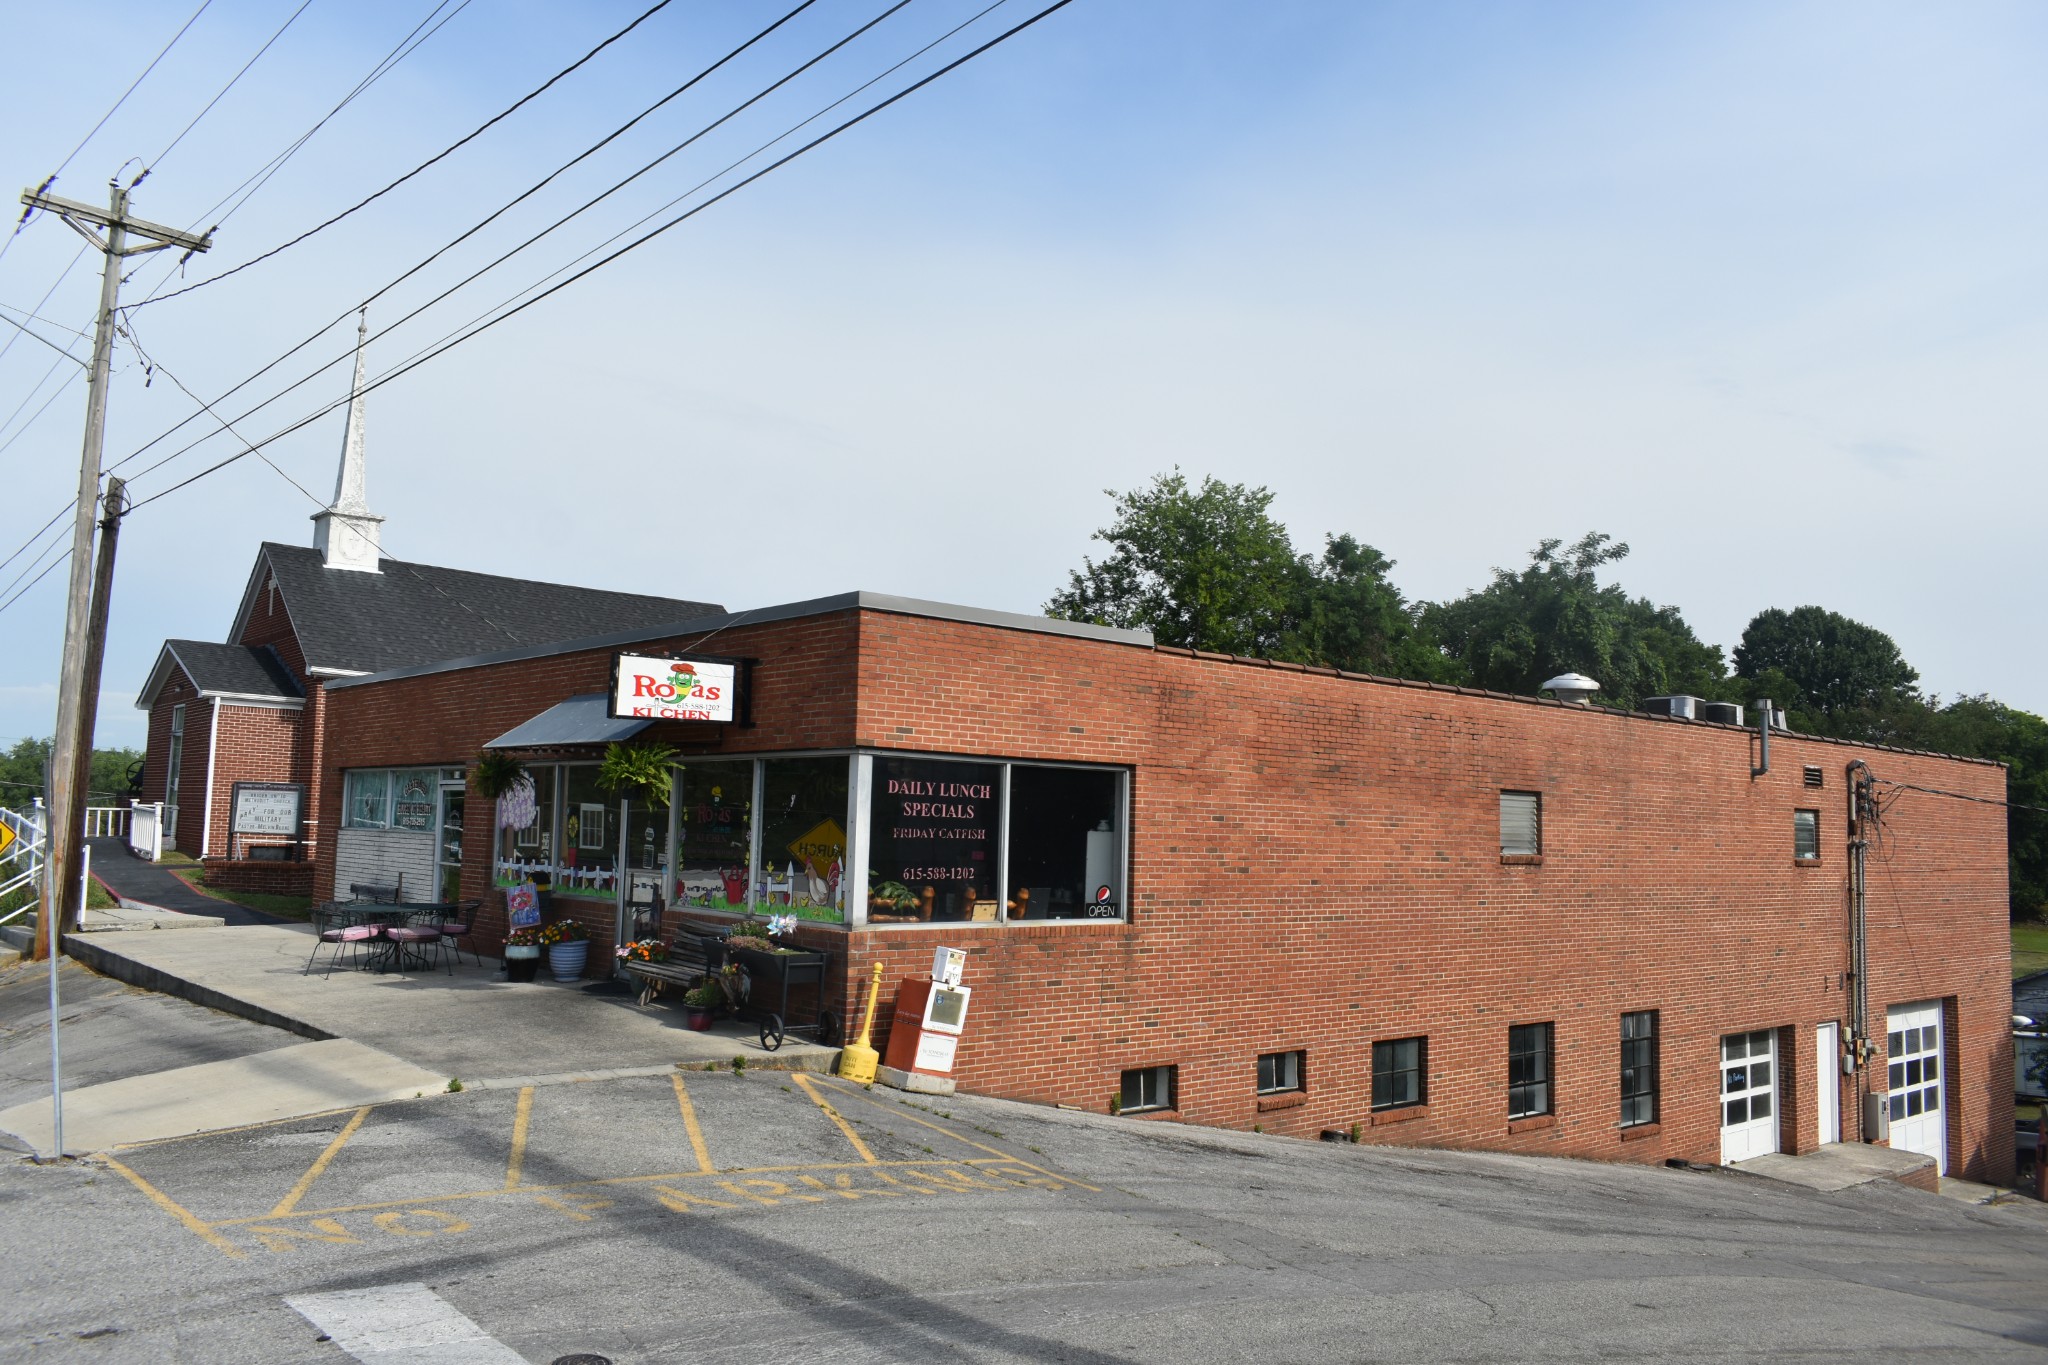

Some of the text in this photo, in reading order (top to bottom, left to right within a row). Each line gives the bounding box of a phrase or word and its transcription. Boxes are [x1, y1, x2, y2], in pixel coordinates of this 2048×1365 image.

[676, 703, 720, 711] 615-588-1202
[888, 780, 991, 799] DAILY LUNCH
[903, 802, 975, 818] SPECIALS
[254, 815, 282, 823] MILITARY
[893, 828, 986, 839] FRIDAY CATFISH
[903, 867, 975, 880] 615-588-1202
[1088, 905, 1115, 917] OPEN
